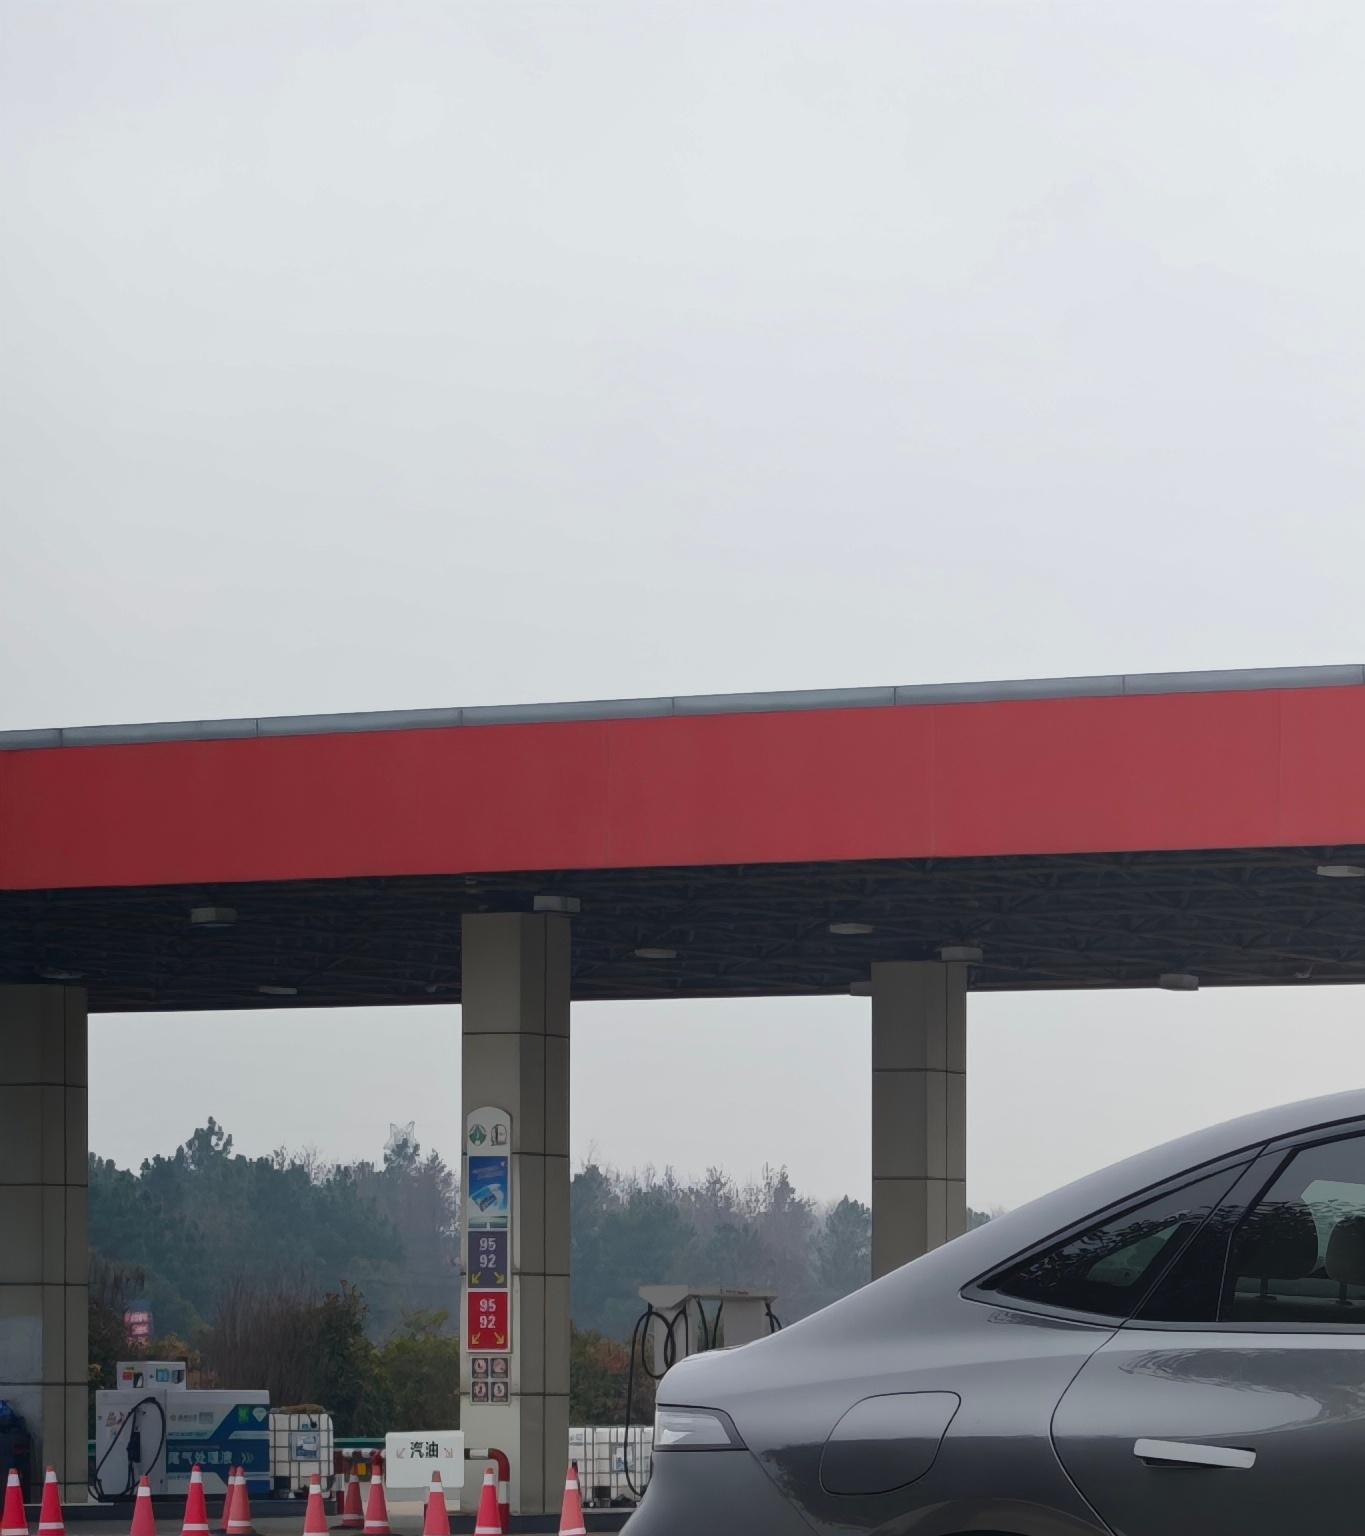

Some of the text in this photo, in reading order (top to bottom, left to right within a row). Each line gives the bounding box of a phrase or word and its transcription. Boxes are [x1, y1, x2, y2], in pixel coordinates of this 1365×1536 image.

[479, 1237, 497, 1251] 95
[479, 1254, 497, 1268] 92
[479, 1298, 497, 1312] 95
[479, 1315, 497, 1329] 92
[410, 1440, 439, 1459] 汽油
